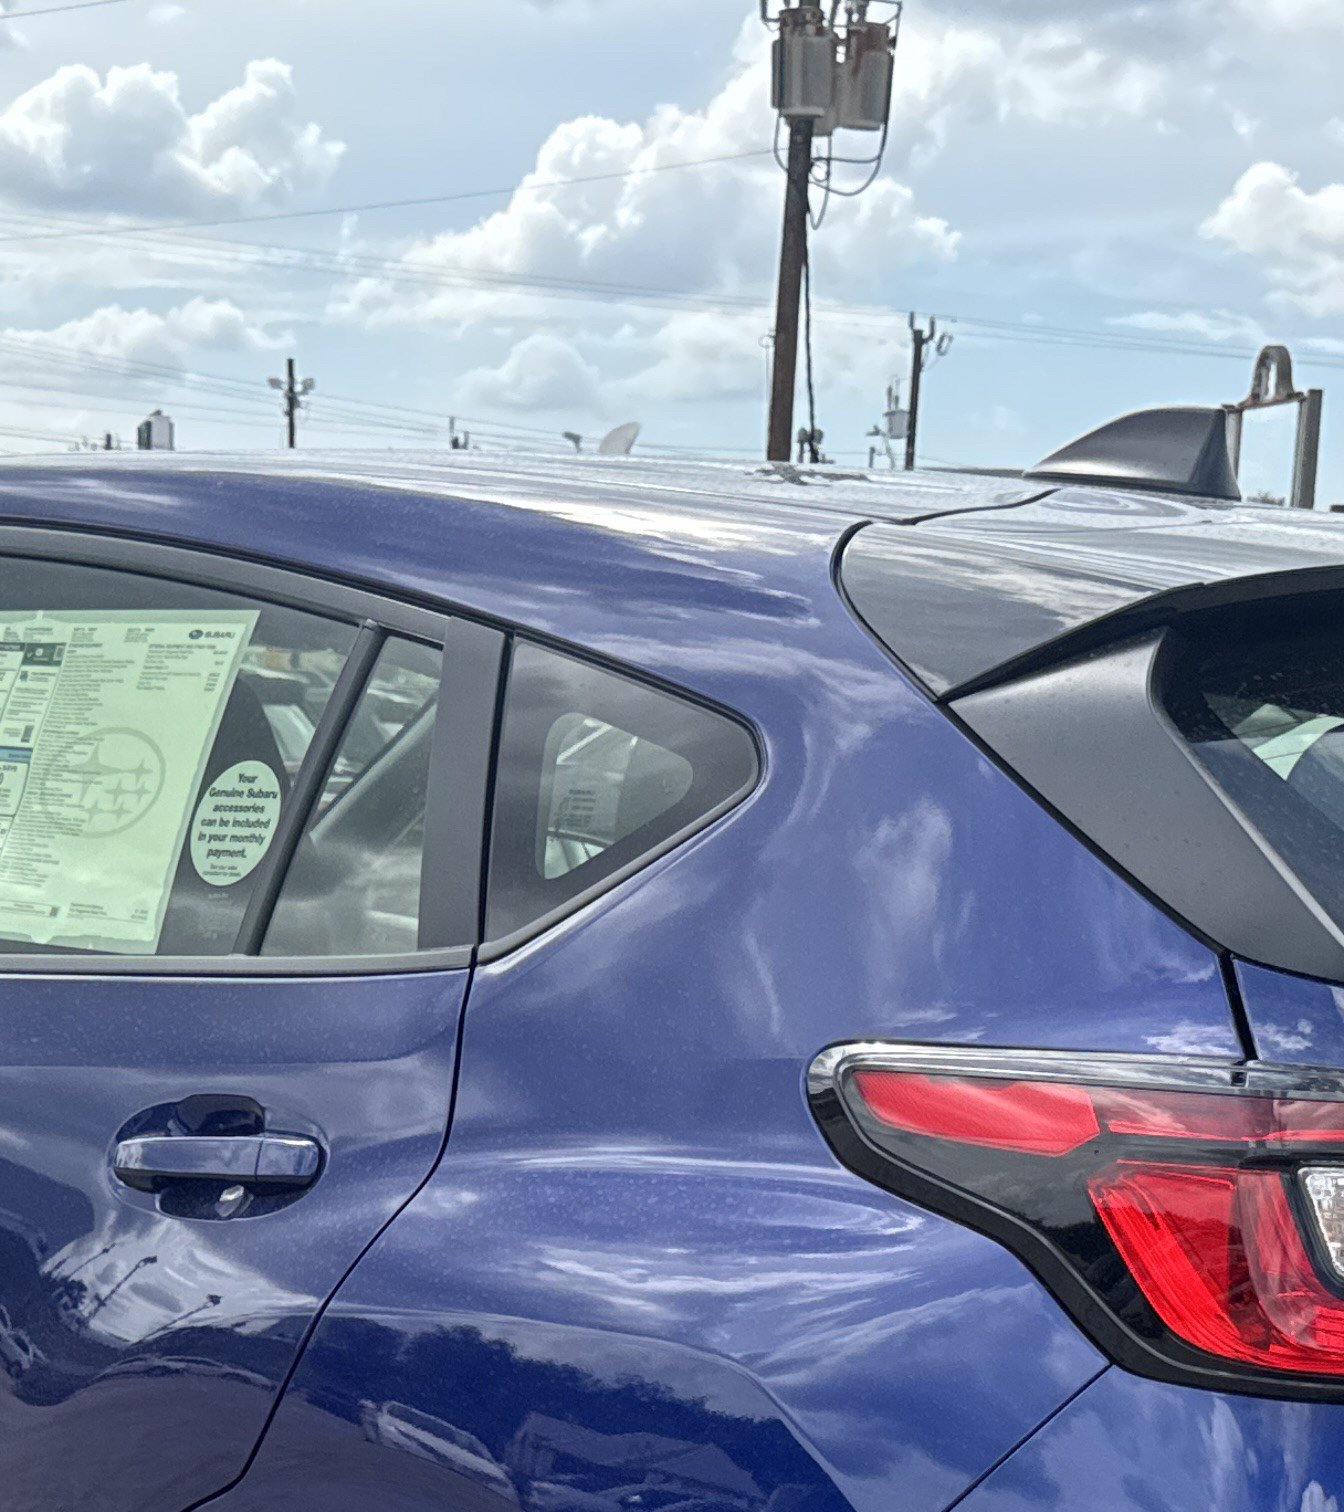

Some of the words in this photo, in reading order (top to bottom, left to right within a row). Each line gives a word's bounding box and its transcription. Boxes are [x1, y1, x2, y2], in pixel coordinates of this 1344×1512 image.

[238, 773, 258, 783] Your
[209, 787, 245, 798] Genuine
[247, 788, 278, 799] Subaru
[213, 803, 265, 814] accessories
[201, 818, 217, 827] can
[219, 817, 230, 828] be
[232, 818, 271, 829] included
[208, 833, 228, 843] your
[229, 832, 266, 846] monthly
